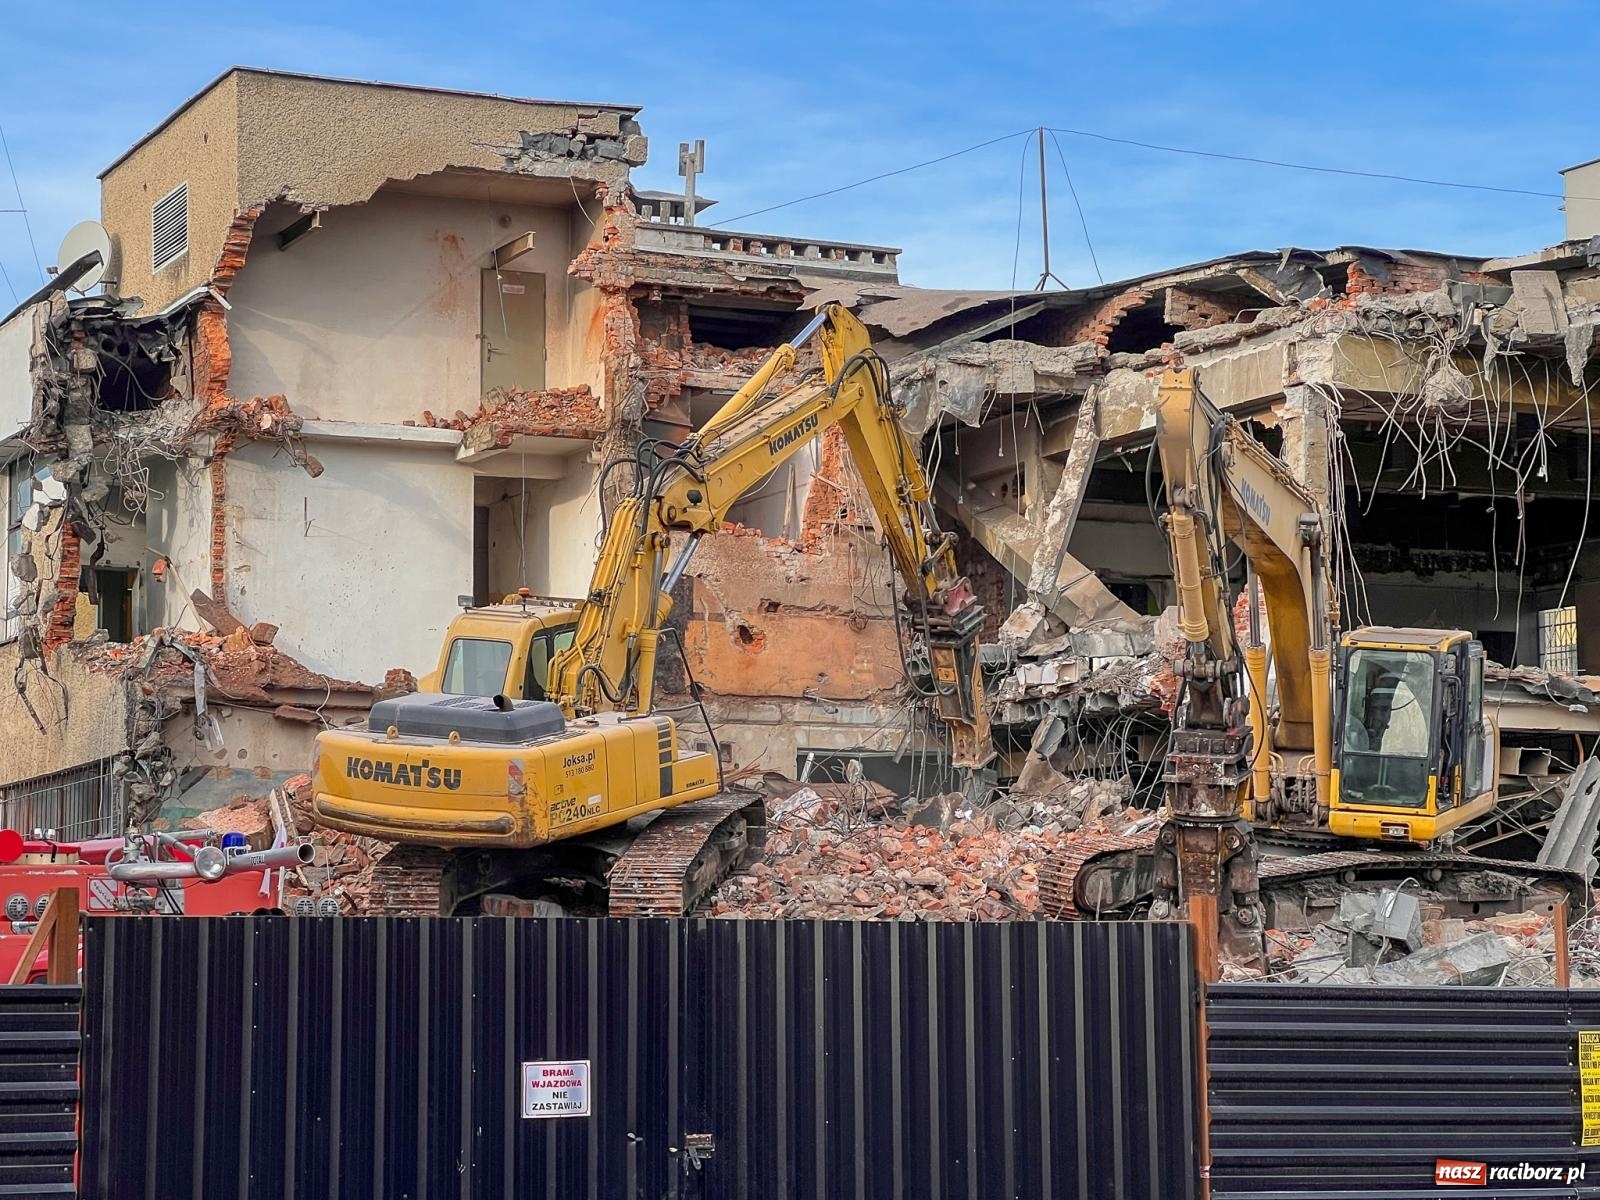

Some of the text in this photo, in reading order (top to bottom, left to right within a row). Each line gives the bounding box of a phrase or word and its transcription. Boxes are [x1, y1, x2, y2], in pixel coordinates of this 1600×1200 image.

[768, 413, 818, 456] KOMATSU
[1241, 478, 1271, 526] KOMATSU
[563, 748, 595, 768] Joksa.pl
[347, 756, 461, 790] KOMATSU
[542, 1069, 575, 1077] BRAMA
[531, 1079, 582, 1089] WJAZDOWA
[552, 1091, 568, 1099] NIE
[532, 1101, 582, 1111] ZASTAWIAJ
